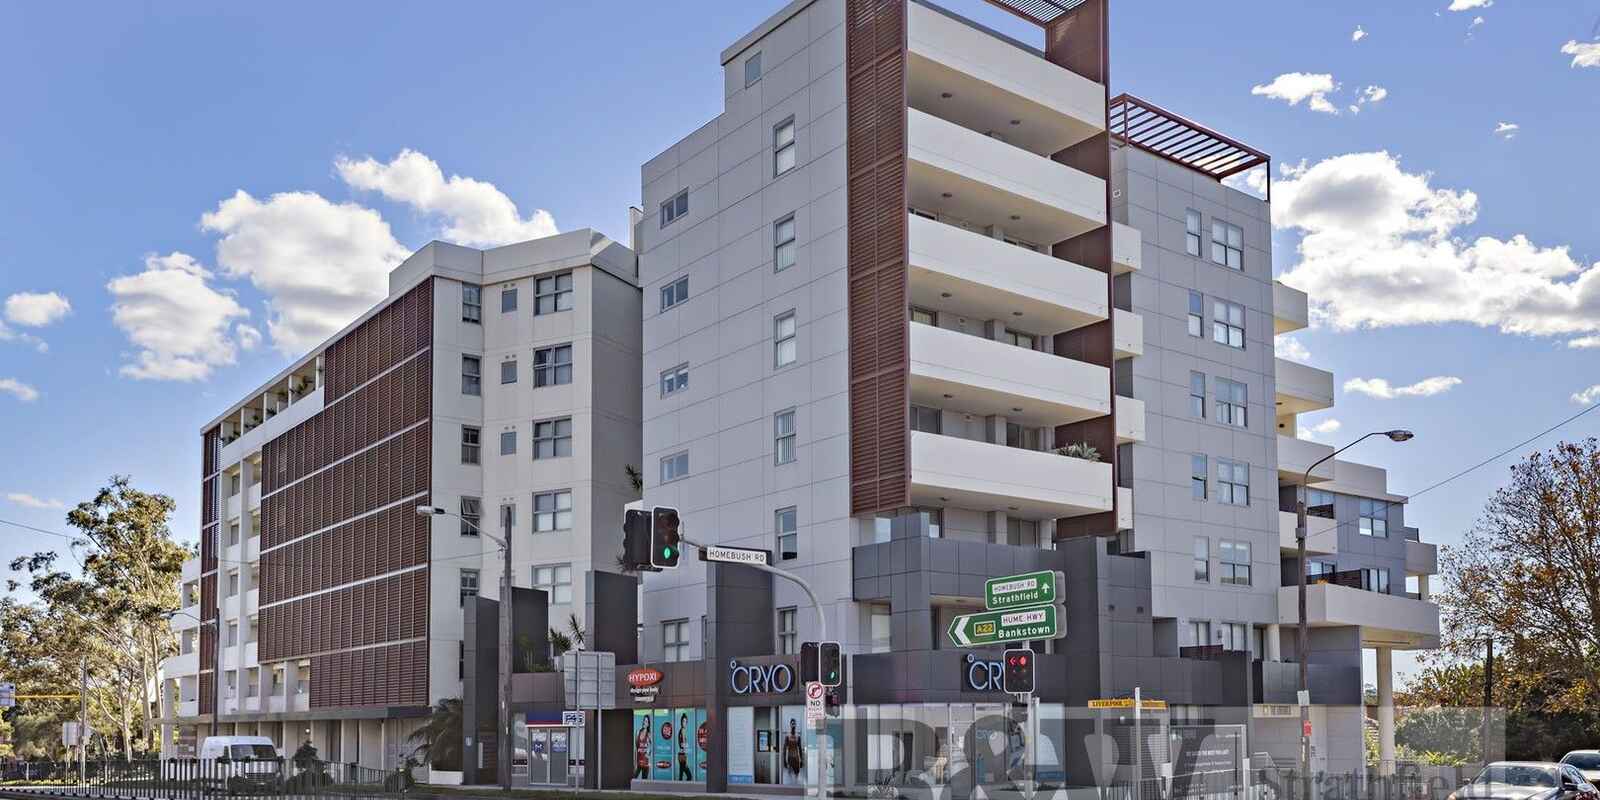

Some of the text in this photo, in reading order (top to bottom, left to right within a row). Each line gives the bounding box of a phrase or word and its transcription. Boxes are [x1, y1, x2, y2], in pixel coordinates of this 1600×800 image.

[708, 550, 752, 561] HOMEBUSH
[993, 581, 1025, 592] HOMEBUSH
[992, 591, 1039, 605] Strathfield
[1003, 612, 1044, 624] HUME HWY
[977, 624, 993, 633] A22
[998, 626, 1050, 639] Bankstown
[628, 671, 657, 682] HYPOXI
